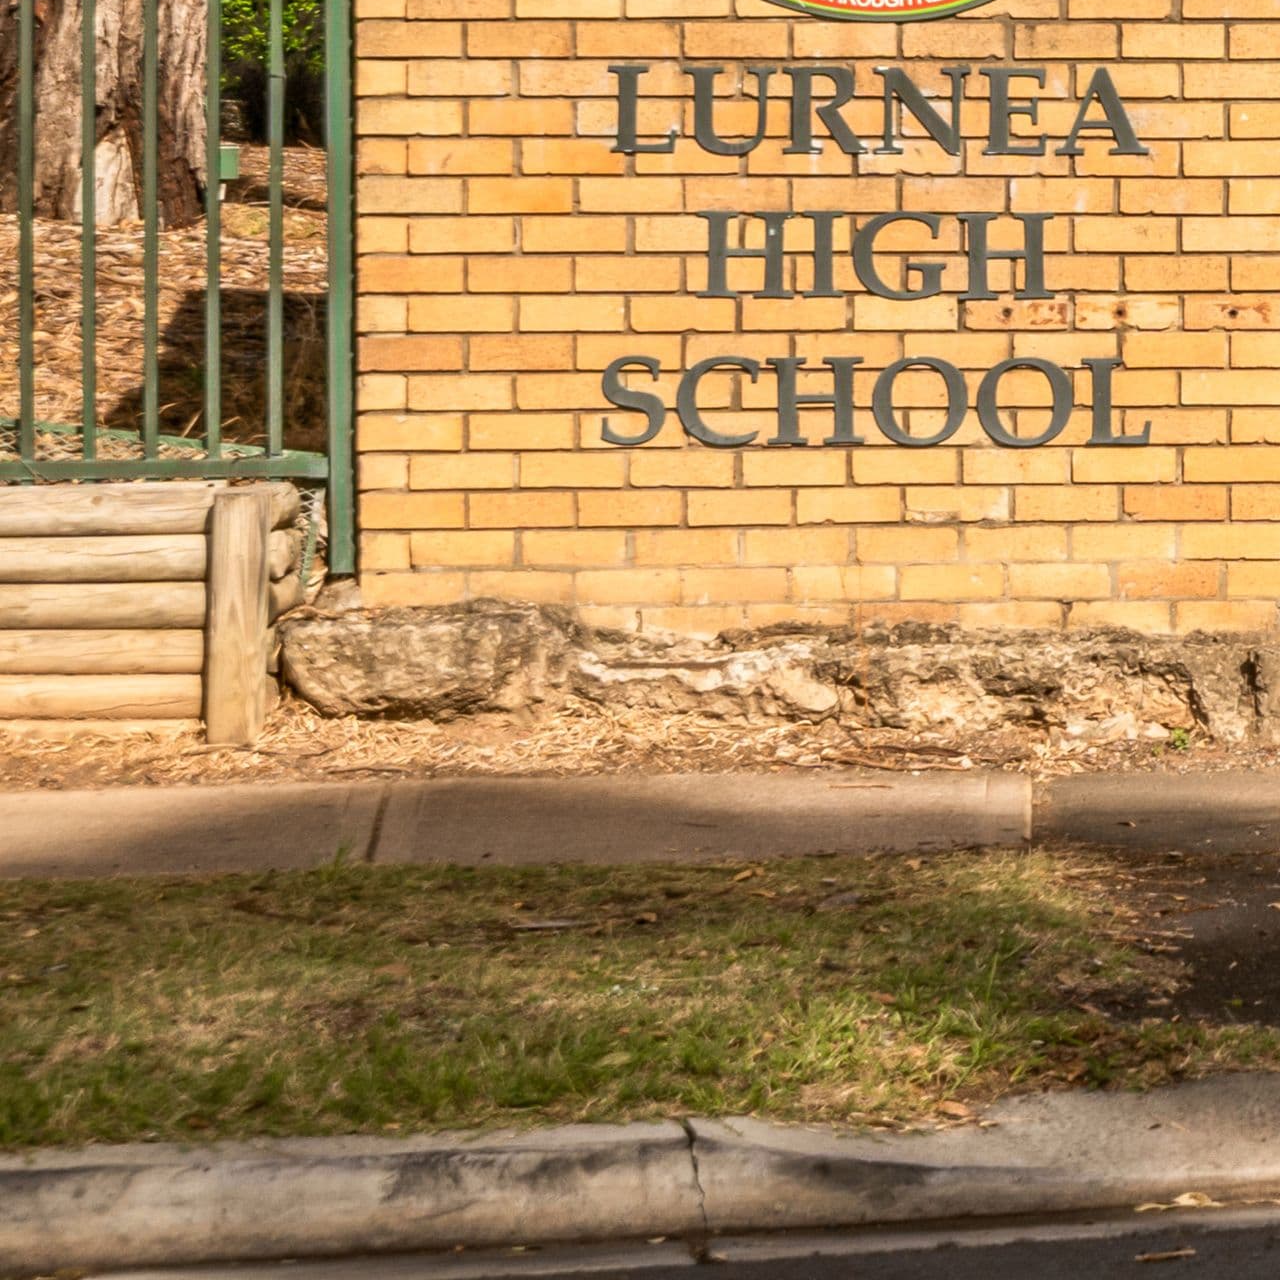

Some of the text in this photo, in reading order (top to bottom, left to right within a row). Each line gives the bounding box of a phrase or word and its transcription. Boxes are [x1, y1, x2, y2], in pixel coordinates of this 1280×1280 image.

[608, 65, 1150, 156] LURNEA
[696, 210, 1056, 301] HIGH
[600, 356, 1152, 448] SCHOOL
